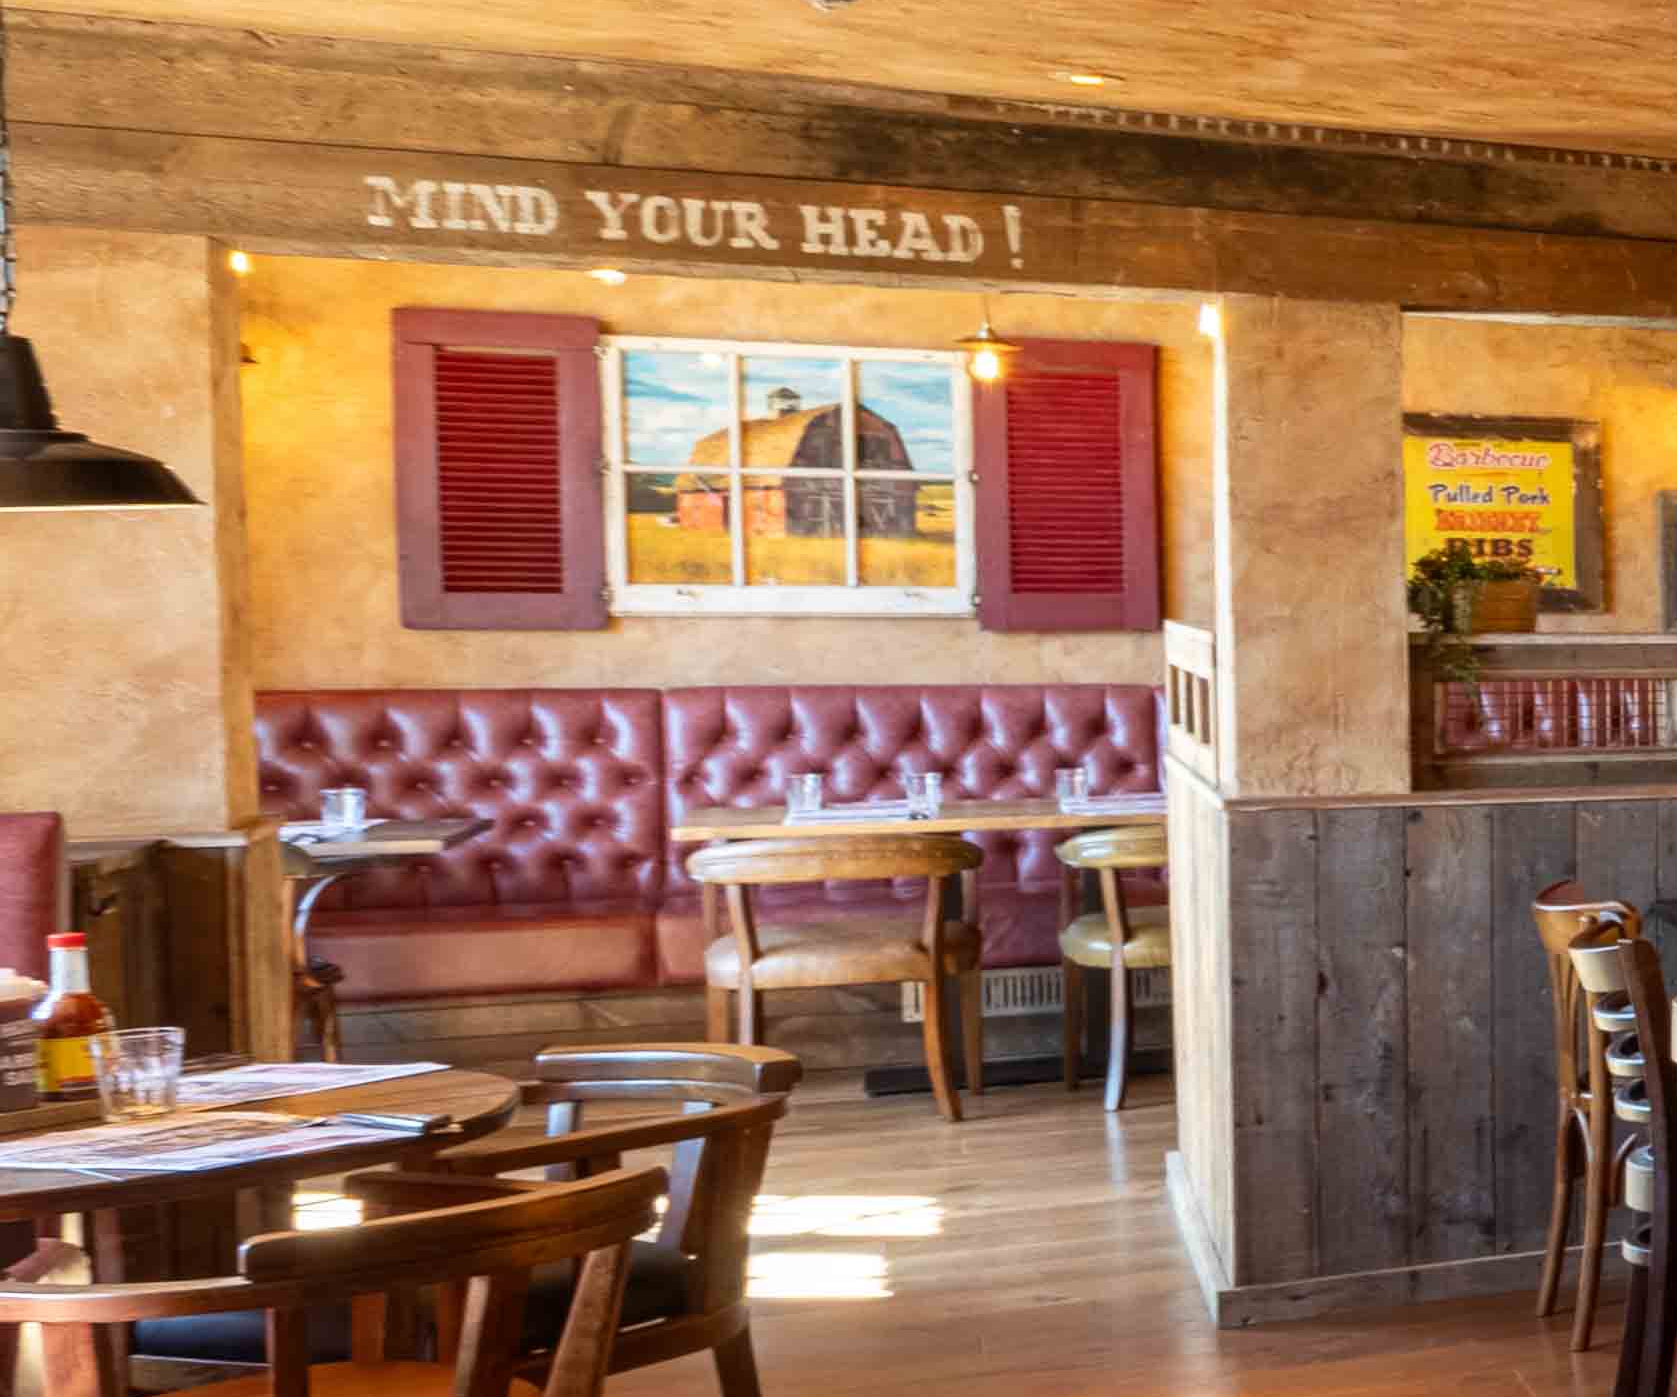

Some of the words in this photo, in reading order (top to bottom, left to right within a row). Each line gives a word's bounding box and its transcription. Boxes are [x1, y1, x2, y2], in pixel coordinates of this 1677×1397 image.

[364, 176, 559, 236] MIND
[585, 190, 779, 252] YOUR
[1428, 442, 1552, 470] Barbecue
[1429, 483, 1493, 504] Pulled
[1500, 485, 1552, 506] Pork
[1447, 538, 1535, 559] RIBS
